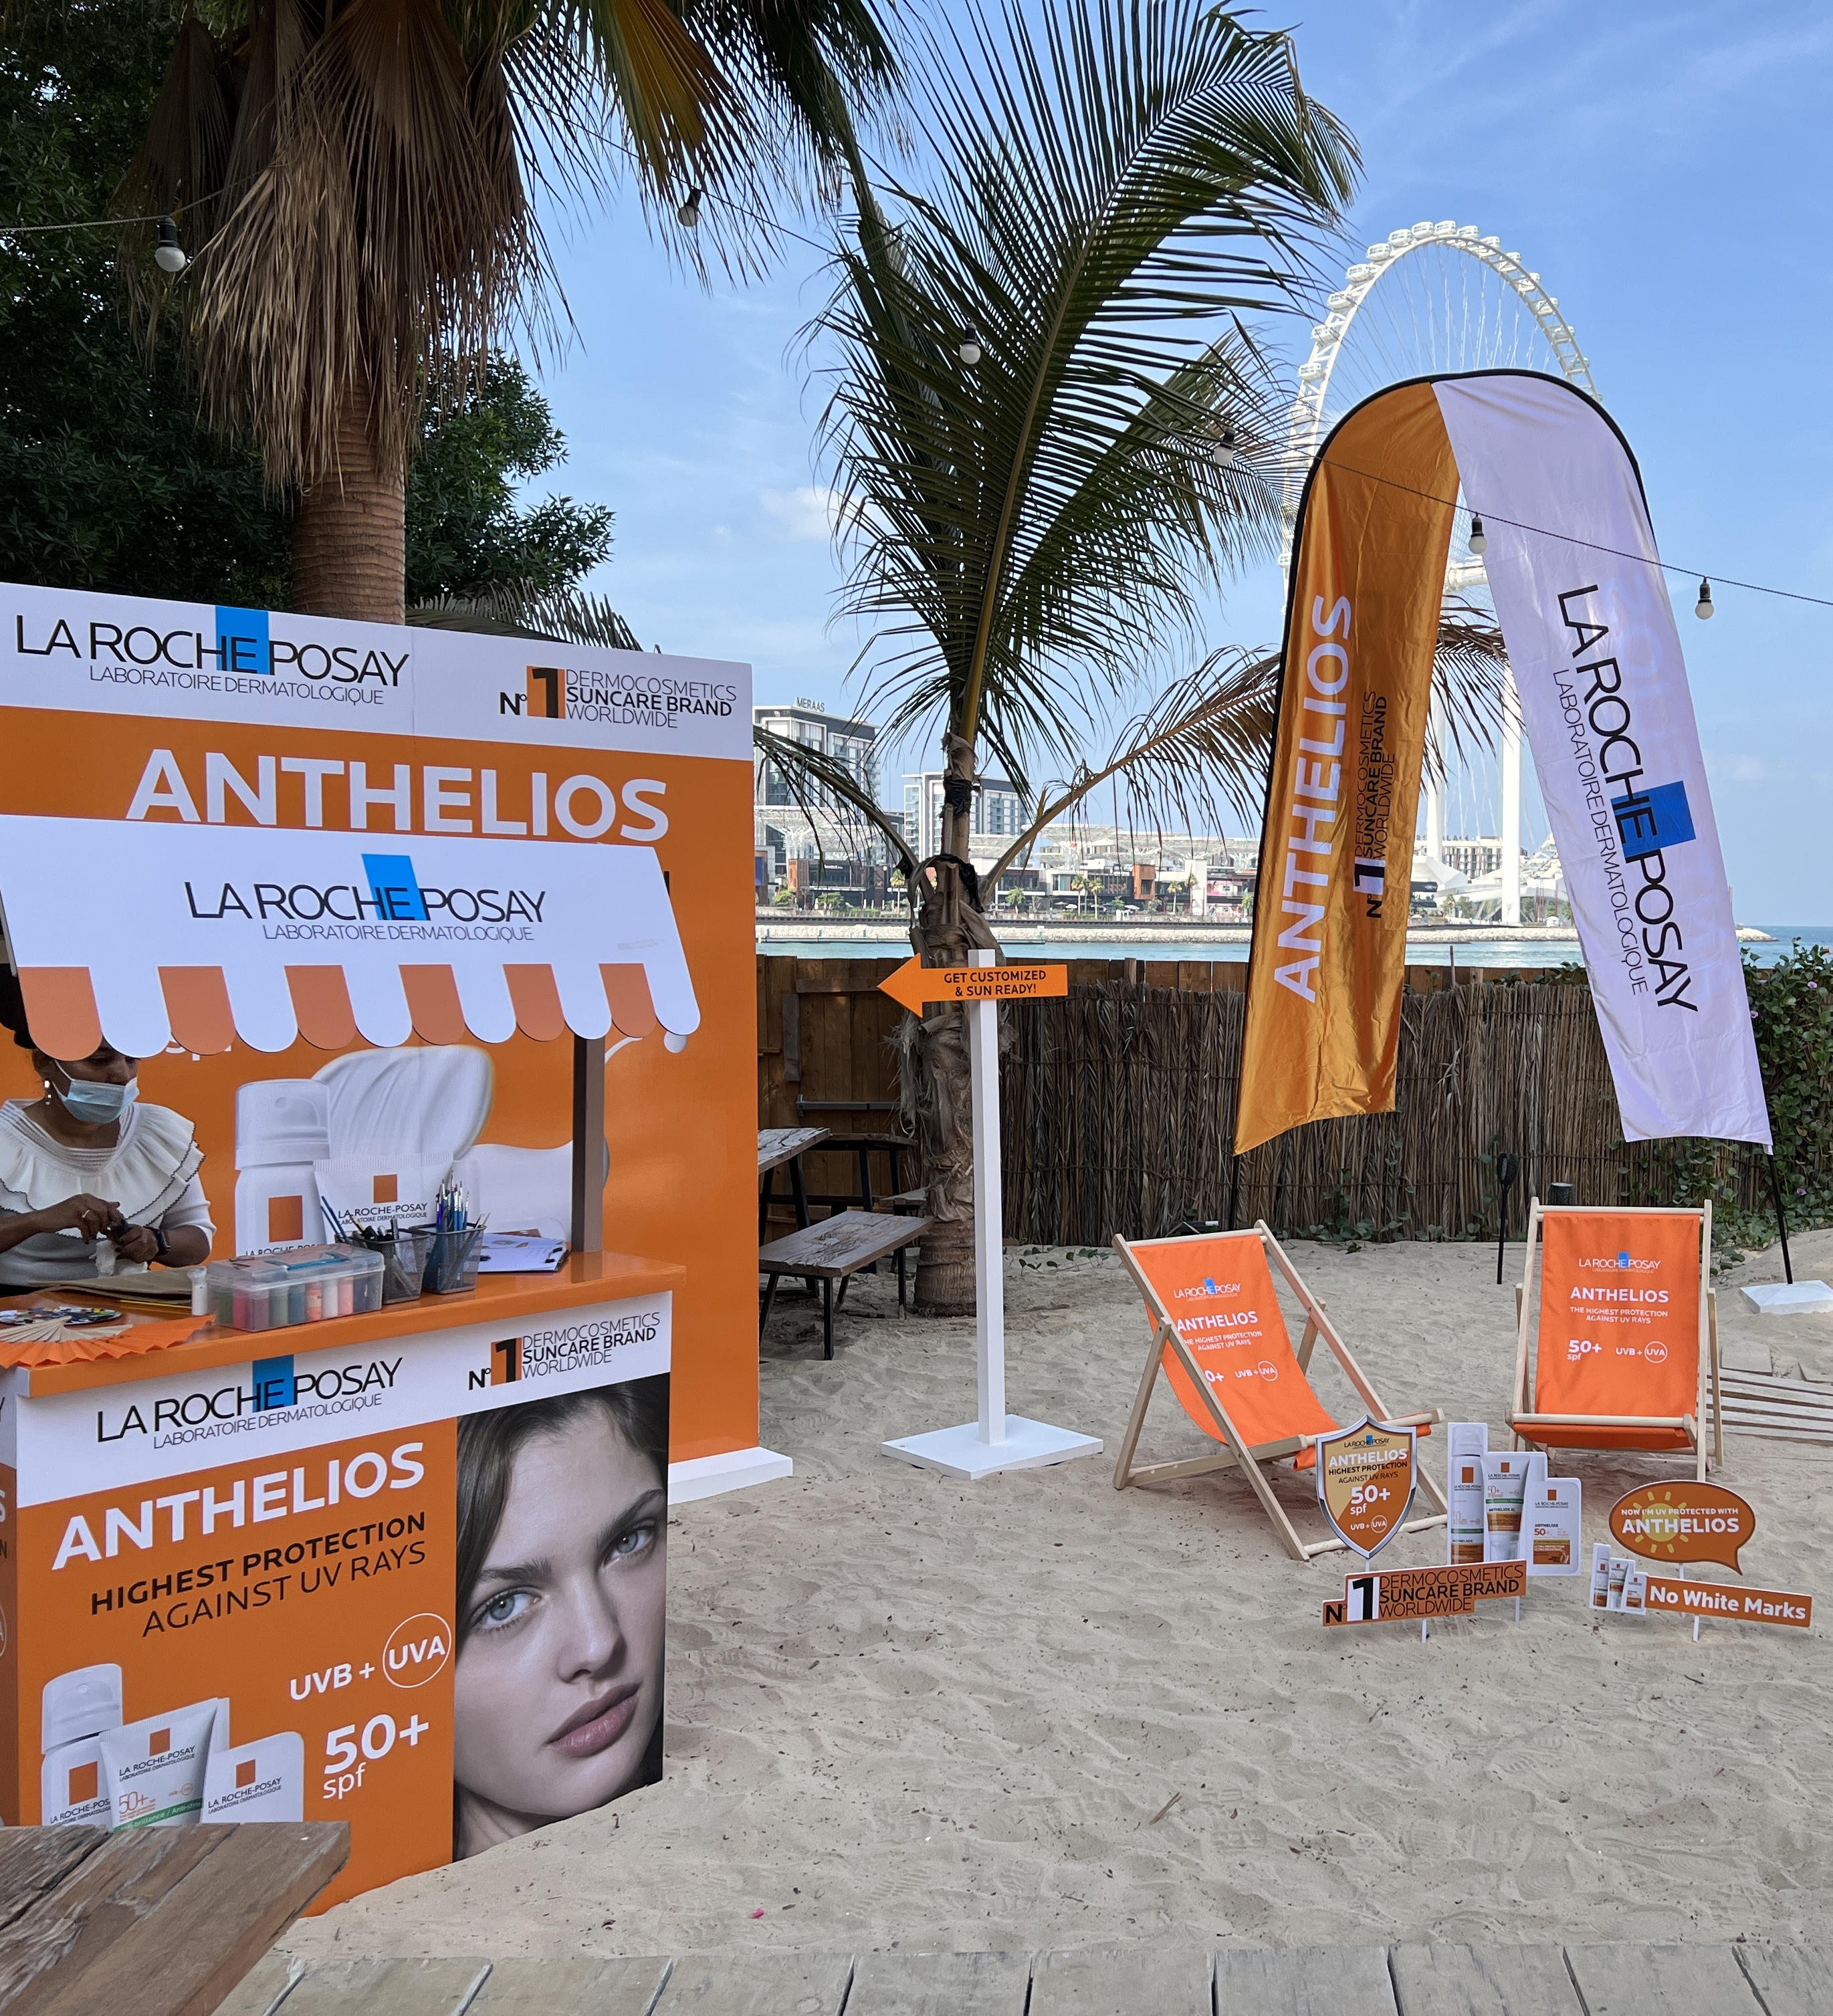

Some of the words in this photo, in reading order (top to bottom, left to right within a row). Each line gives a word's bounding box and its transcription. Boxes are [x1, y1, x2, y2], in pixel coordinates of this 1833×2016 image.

[1557, 584, 1609, 658] LA
[16, 615, 82, 658] LA
[90, 623, 259, 674] ROCHE
[269, 641, 410, 687] POSAY
[90, 665, 222, 691] LABORATOIRE
[225, 677, 384, 705] DERMATOLOGIQUE
[566, 669, 737, 702] DERMOCOSMETICS
[566, 687, 661, 711] SUNCARE
[667, 697, 732, 717] BRAND
[796, 697, 825, 712] MERAAS
[566, 703, 678, 729] WORLDWIDE
[1371, 695, 1387, 762] BRAND
[1576, 657, 1657, 844] ROCHE
[1355, 691, 1376, 857] DERMOCOSMETICS
[126, 749, 669, 842] ANTHELIOS
[1274, 595, 1352, 1004] ANTHELIOS
[1373, 754, 1395, 859] WORLDWIDE
[1363, 765, 1380, 859] SUNCARE
[1553, 669, 1604, 810] LABORATOIRE
[1594, 811, 1648, 994] DERMATOLOGIQUE
[184, 881, 253, 919] LA
[253, 883, 415, 921] ROCHE
[418, 887, 546, 923] POSAY
[263, 924, 387, 940] LABORATOIRE
[388, 925, 534, 944] DERMATOLOGIQUE
[1624, 849, 1698, 1012] POSAY
[944, 973, 967, 984] GET
[970, 970, 1046, 982] CUSTOMIZED
[955, 987, 963, 997] &
[967, 985, 991, 996] SUN
[995, 984, 1037, 995] READY!
[338, 1210, 353, 1219] LA
[354, 1203, 427, 1216] ROCHE-POSAY
[1578, 1258, 1592, 1267] LA
[1592, 1258, 1628, 1268] ROCHE
[1628, 1259, 1661, 1269] POSAY
[1173, 1289, 1185, 1299] LA
[1184, 1286, 1214, 1297] ROCHE
[1214, 1283, 1241, 1294] POSAY
[1570, 1286, 1669, 1303] ANTHELIOS
[1177, 1311, 1259, 1332] ANTHELIOS
[1620, 1309, 1668, 1317] PROTECTION
[523, 1312, 661, 1350] DERMOCOSMETICS
[1195, 1336, 1222, 1345] HIGHEST
[1223, 1331, 1263, 1341] PROTECTION
[522, 1337, 600, 1364] SUNCARE
[604, 1327, 656, 1349] BRAND
[1198, 1343, 1225, 1351] AGAINST
[1567, 1352, 1582, 1362] spf
[1568, 1339, 1602, 1353] 50+
[1616, 1347, 1636, 1355] UVB
[1646, 1348, 1666, 1357] UVA
[522, 1349, 612, 1378] WORLDWIDE
[1204, 1369, 1224, 1382] 0+
[1234, 1369, 1253, 1378] UVB
[1260, 1367, 1276, 1375] UVA
[97, 1405, 148, 1443] LA
[154, 1378, 285, 1432] ROCHE
[293, 1357, 403, 1406] POSAY
[154, 1418, 257, 1449] LABORATOIRE
[258, 1393, 383, 1430] DERMATOLOGIQUE
[1328, 1466, 1360, 1476] HIGHEST
[1362, 1460, 1408, 1472] PROTECTION
[1329, 1448, 1408, 1468] ANTHELIOS
[1338, 1474, 1368, 1484] AGAINST
[1380, 1471, 1398, 1480] RAYS
[51, 1442, 425, 1571] ANTHELIOS
[1351, 1484, 1391, 1504] 50+
[1350, 1503, 1367, 1516] spf
[1350, 1523, 1365, 1531] UVB
[1373, 1521, 1386, 1529] UVA
[1622, 1518, 1739, 1534] ANTHELIOS
[90, 1559, 233, 1615] HIGHEST
[243, 1512, 426, 1576] PROTECTION
[1380, 1565, 1523, 1589] DERMOCOSMETICS
[142, 1575, 291, 1637] AGAINST
[300, 1563, 342, 1593] UV
[351, 1540, 426, 1581] RAYS
[1379, 1584, 1459, 1603] SUNCARE
[1463, 1579, 1519, 1596] BRAND
[1650, 1585, 1679, 1603] No
[1683, 1589, 1739, 1612] White
[1744, 1597, 1806, 1619] Marks
[1379, 1597, 1471, 1618] WORLDWIDE
[290, 1662, 352, 1700] UVB
[388, 1635, 446, 1671] UVA
[324, 1712, 429, 1776] 50+
[119, 1767, 130, 1776] LA
[133, 1745, 195, 1771] ROCHE-POSAY
[208, 1799, 219, 1808] LA
[221, 1777, 282, 1803] ROCHE-POSAY
[322, 1762, 366, 1799] spf
[60, 1799, 110, 1819] ROCHE-POS
